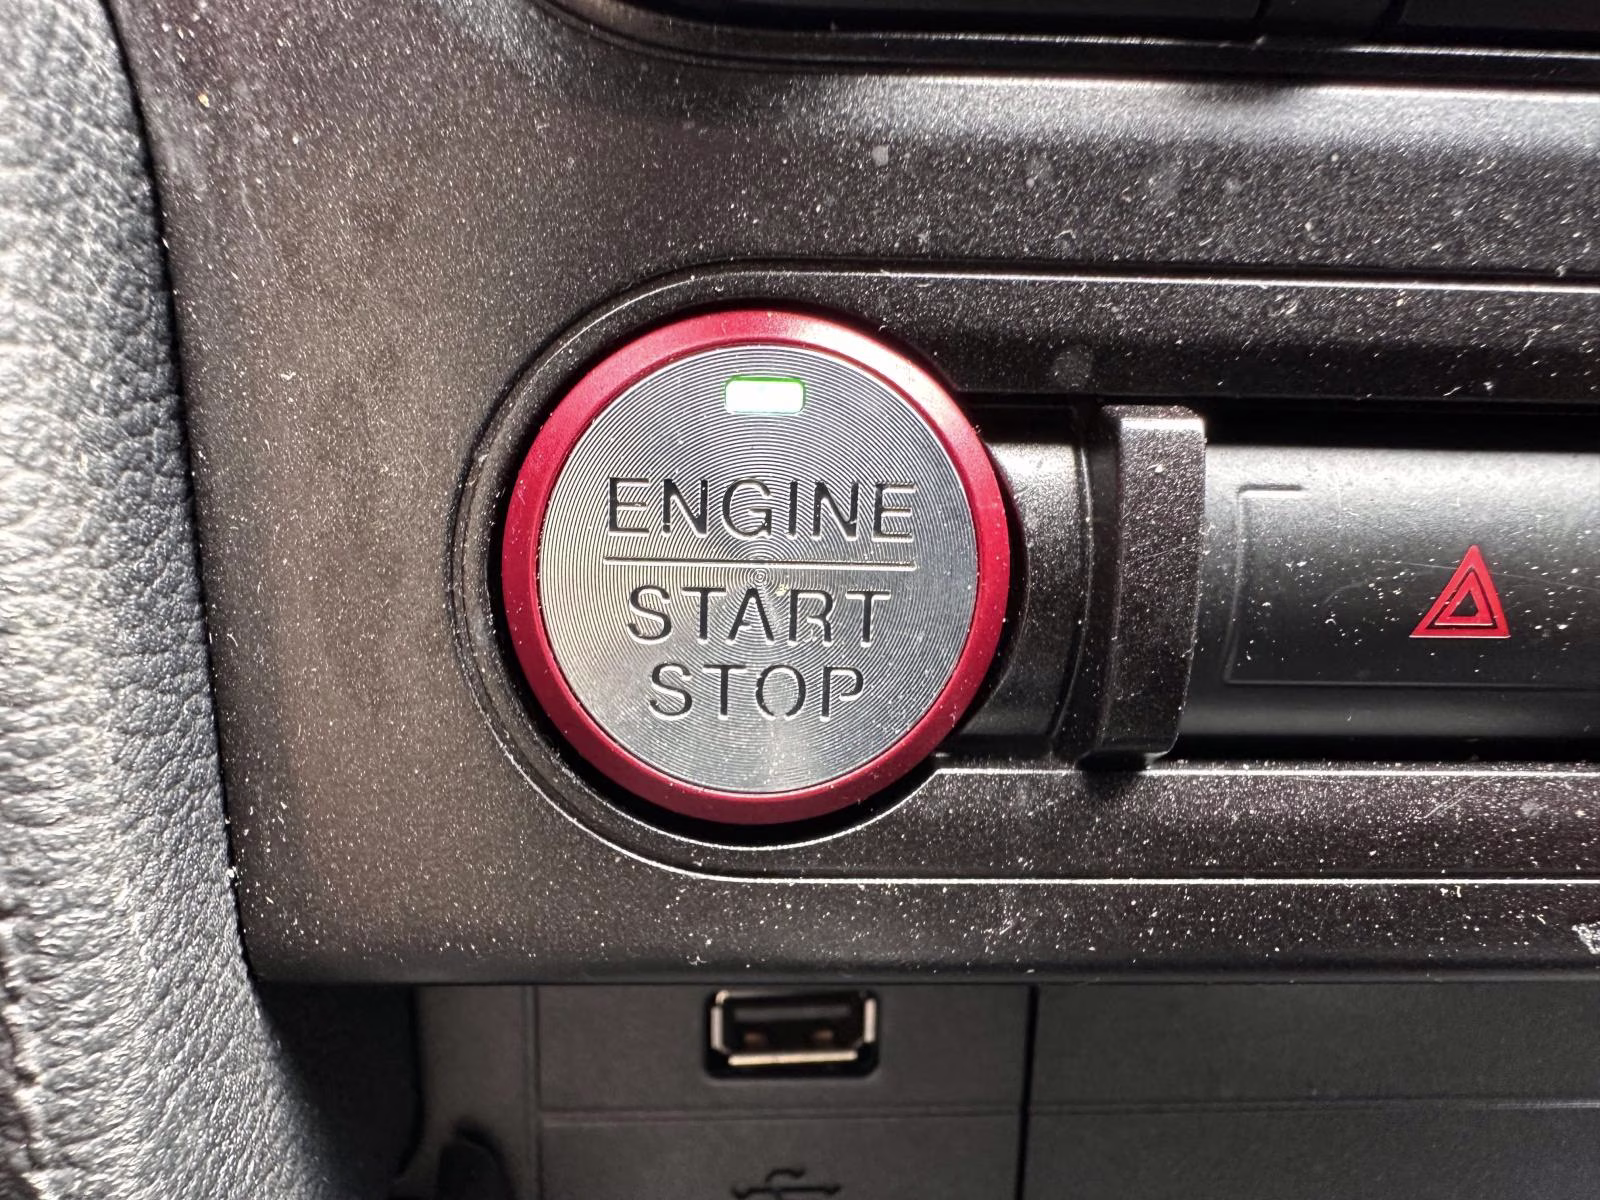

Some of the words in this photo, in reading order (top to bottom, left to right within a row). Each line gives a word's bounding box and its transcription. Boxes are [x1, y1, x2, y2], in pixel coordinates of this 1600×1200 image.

[608, 476, 917, 542] ENGINE
[627, 584, 892, 648] START
[650, 661, 864, 722] STOP
